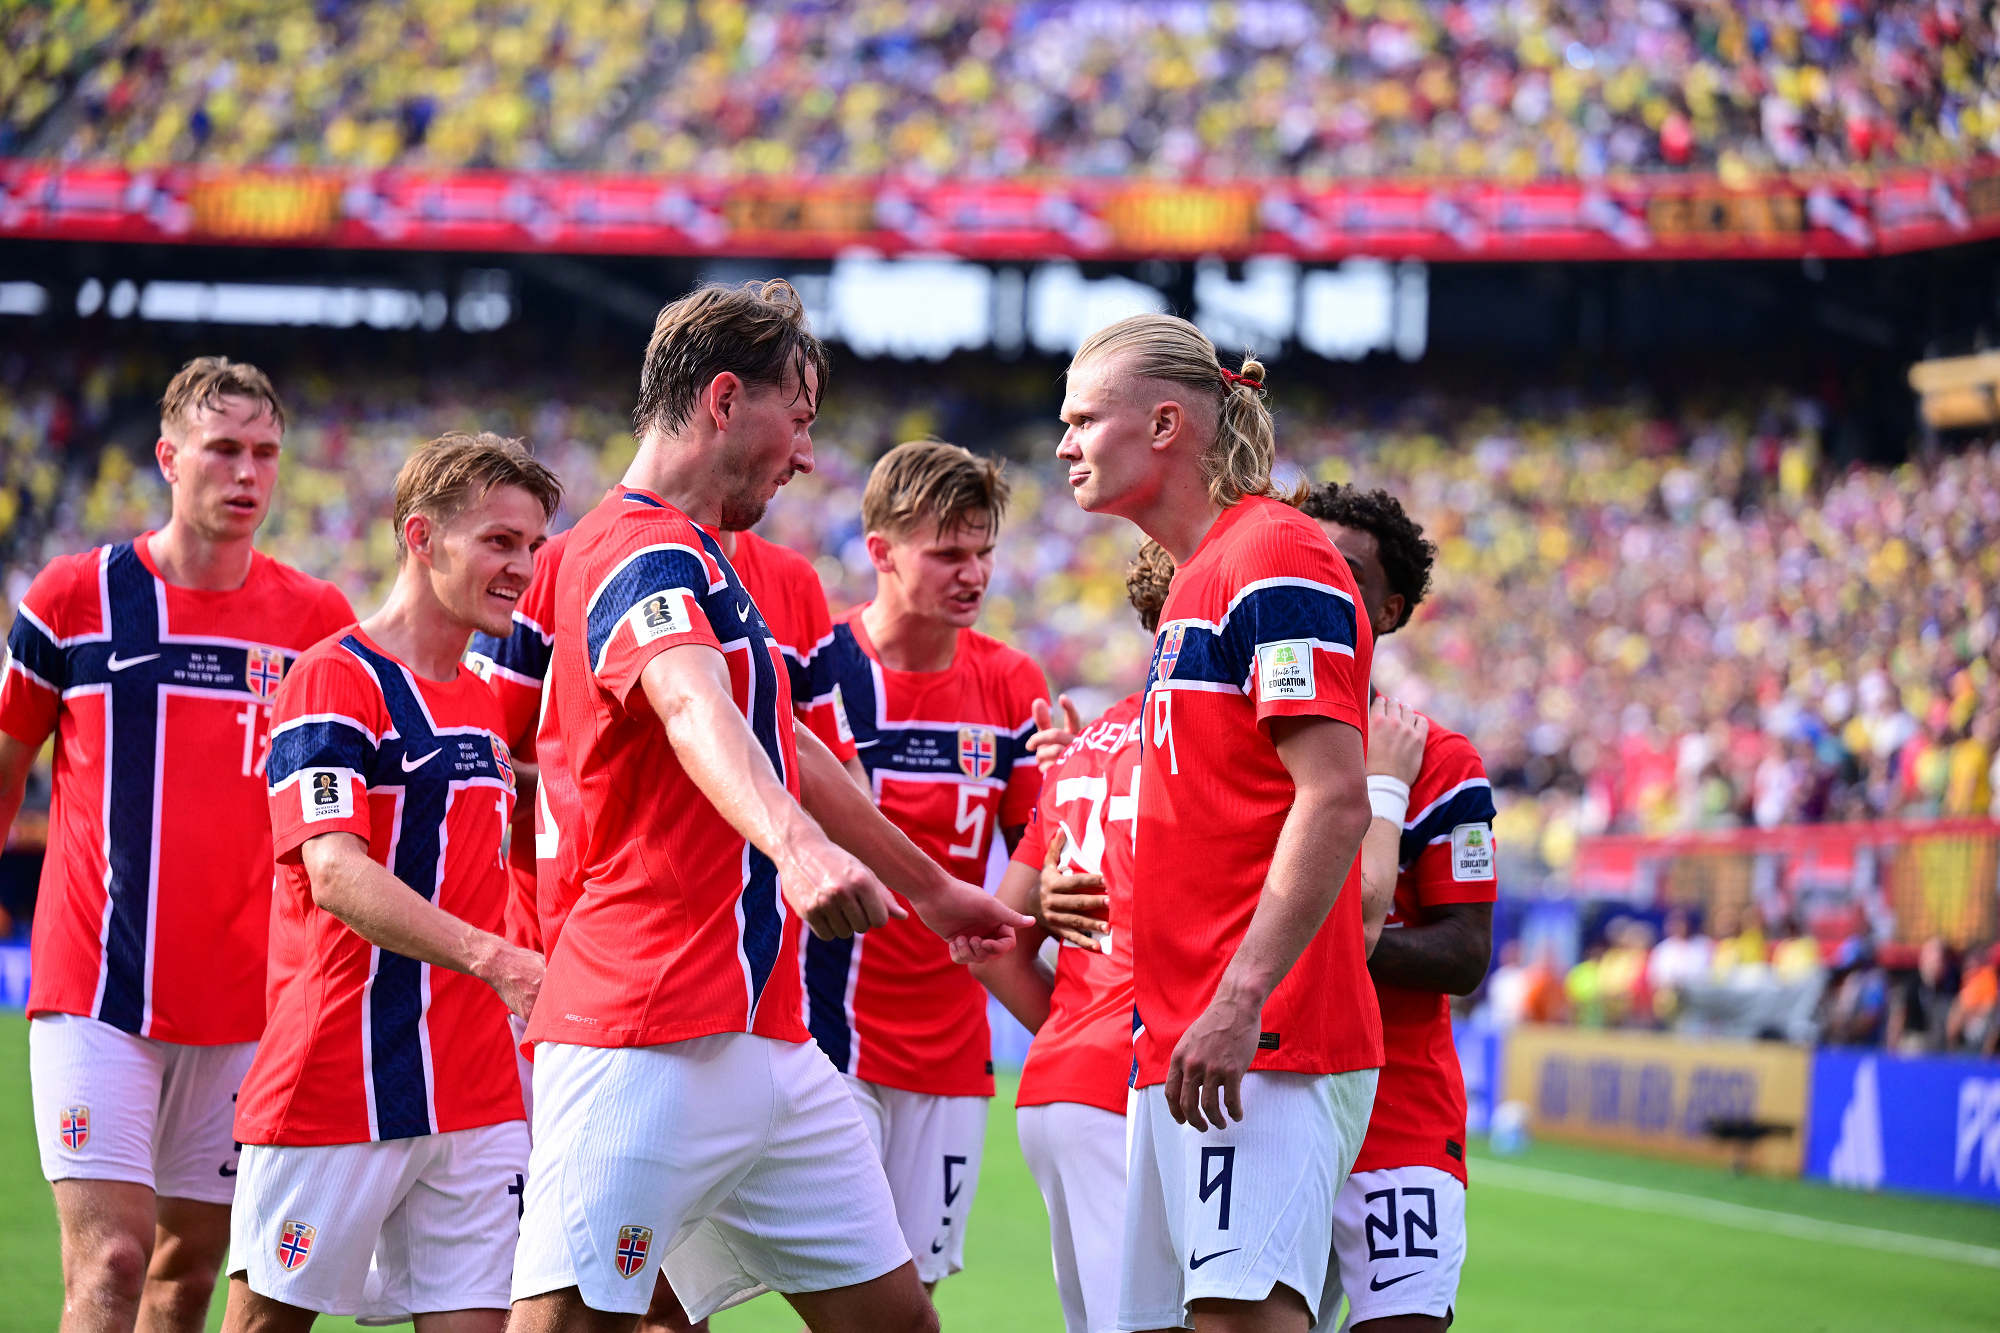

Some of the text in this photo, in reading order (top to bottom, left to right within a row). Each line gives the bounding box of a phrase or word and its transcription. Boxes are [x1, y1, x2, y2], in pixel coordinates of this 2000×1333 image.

[650, 626, 677, 637] 2026
[1290, 665, 1301, 676] For
[1268, 677, 1306, 689] EDUCATION
[1153, 690, 1178, 774] 9
[315, 808, 340, 817] 2026
[948, 785, 990, 860] 5
[1460, 859, 1489, 869] EDUCATION
[564, 1013, 599, 1026] AERO-FIT
[1199, 1146, 1236, 1231] 9
[1364, 1187, 1438, 1263] 22
